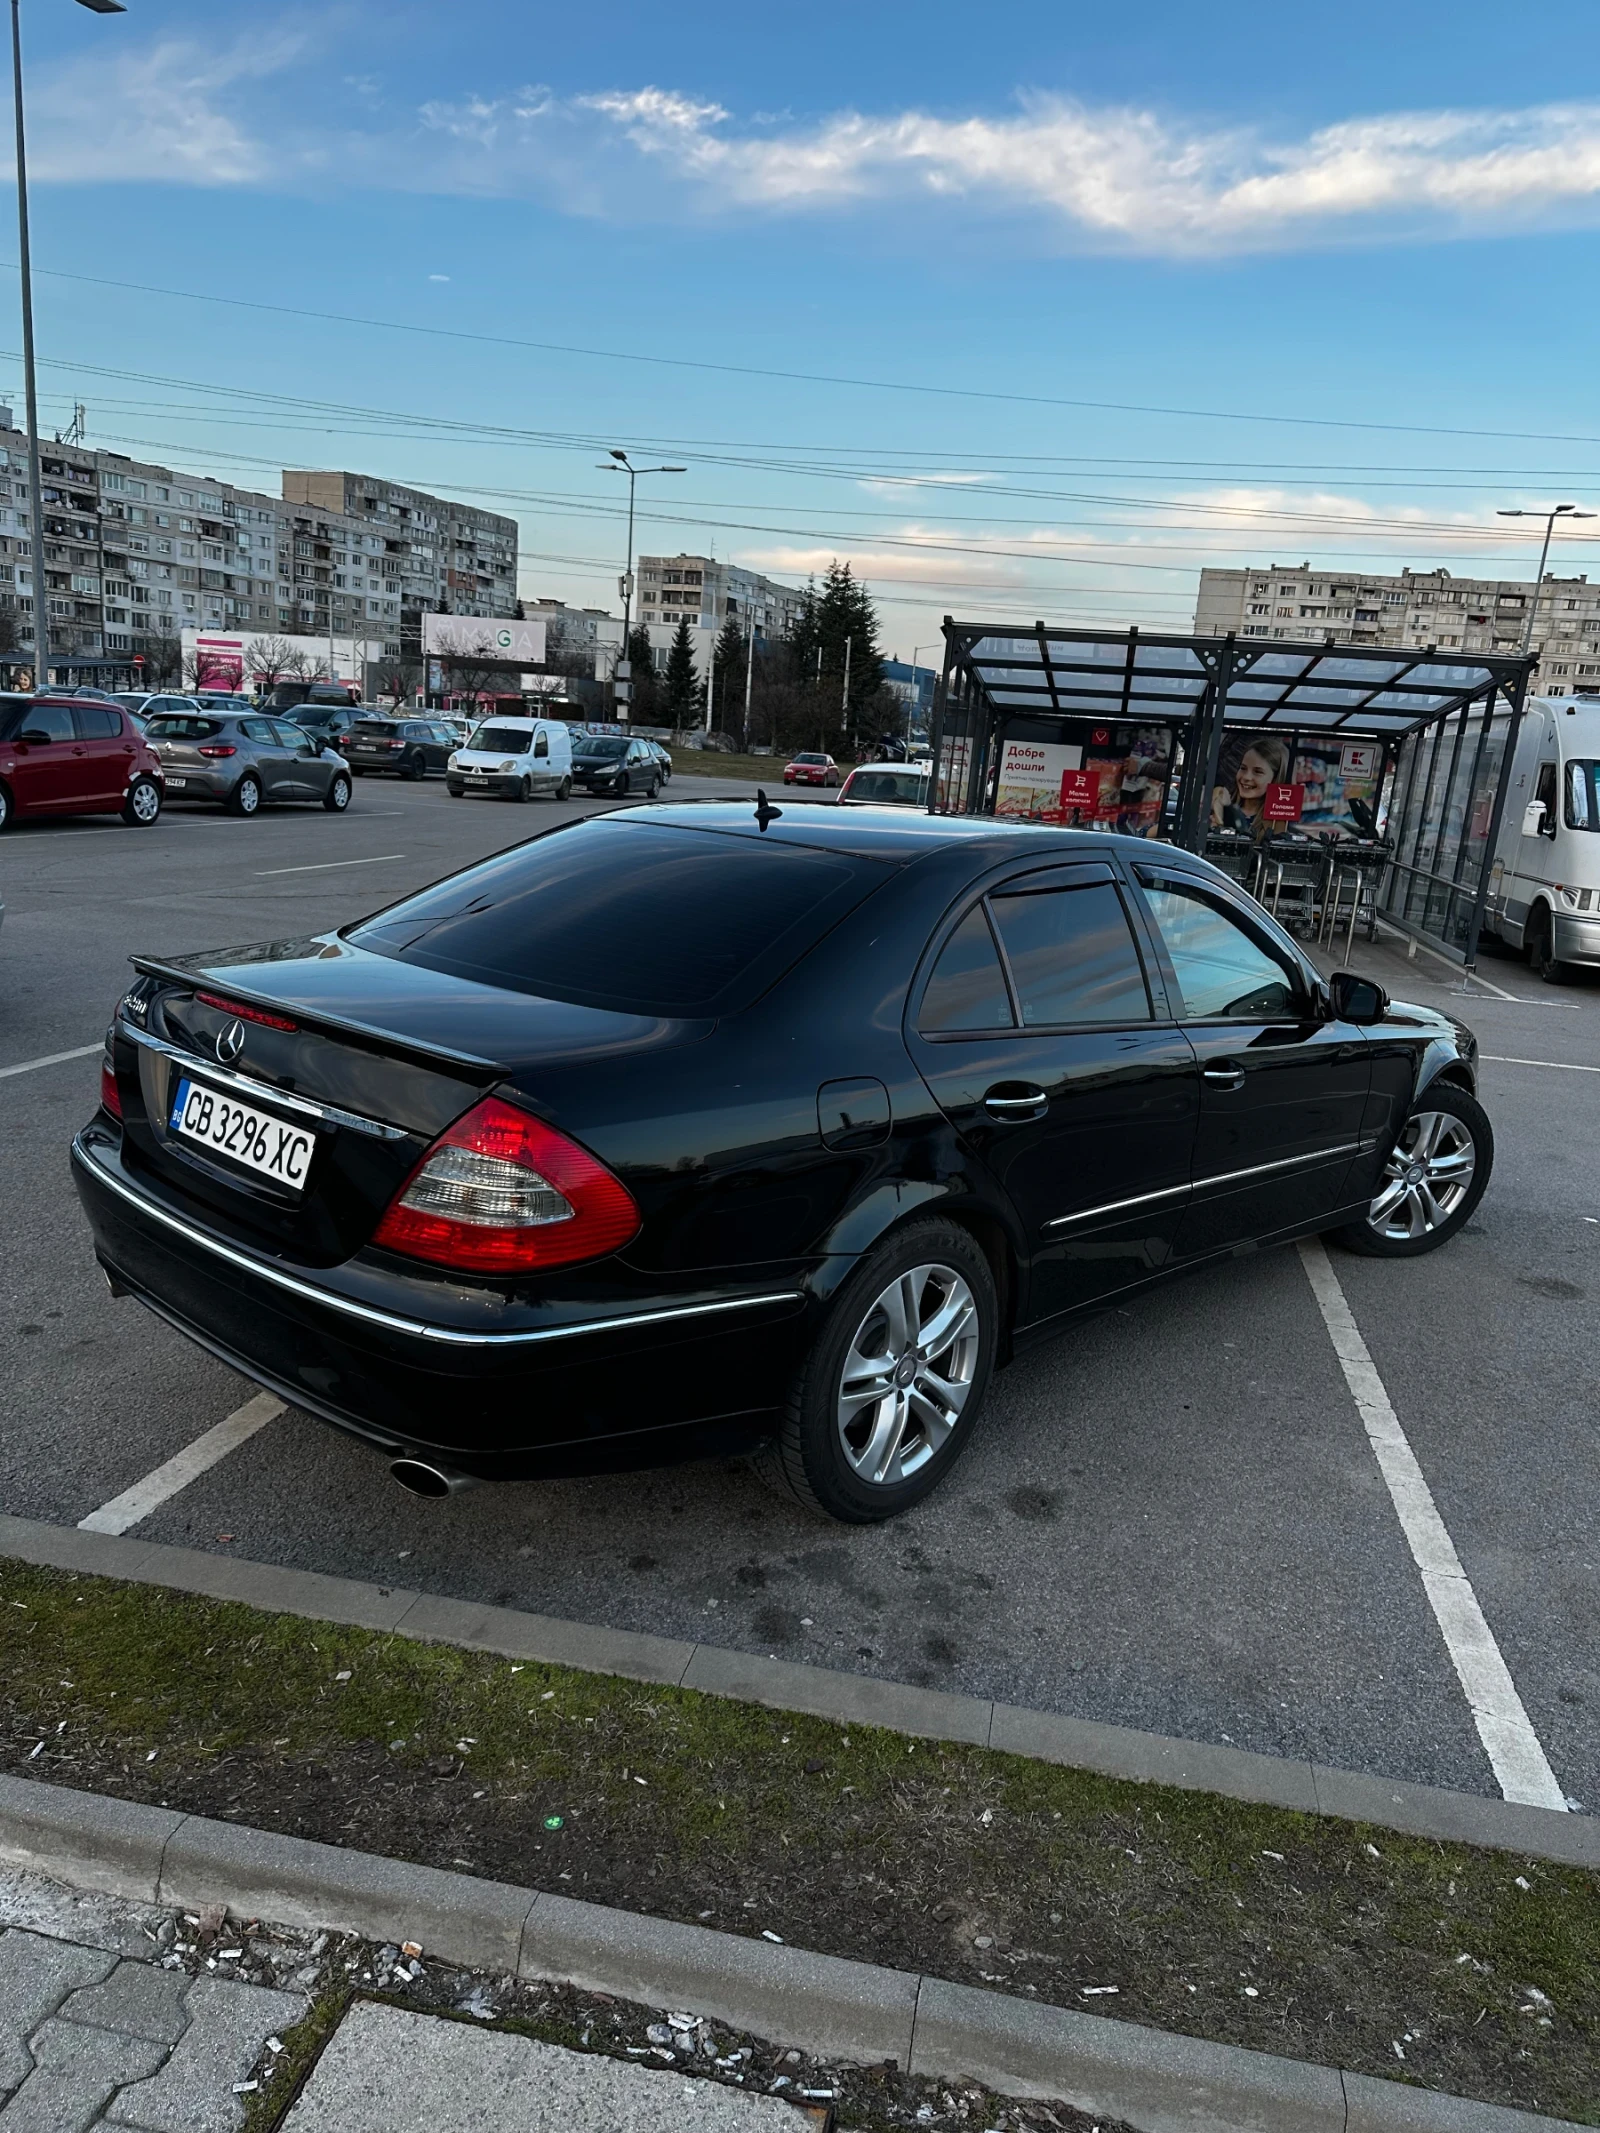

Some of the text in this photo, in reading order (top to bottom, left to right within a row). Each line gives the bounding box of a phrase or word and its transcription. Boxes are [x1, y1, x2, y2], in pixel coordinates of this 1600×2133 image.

[462, 626, 533, 650] MAGIA
[1007, 746, 1046, 760] Добре
[1005, 762, 1045, 772] дошли
[1343, 766, 1369, 774] Kaufland
[1068, 790, 1090, 798] Мелки
[172, 1108, 182, 1123] BG
